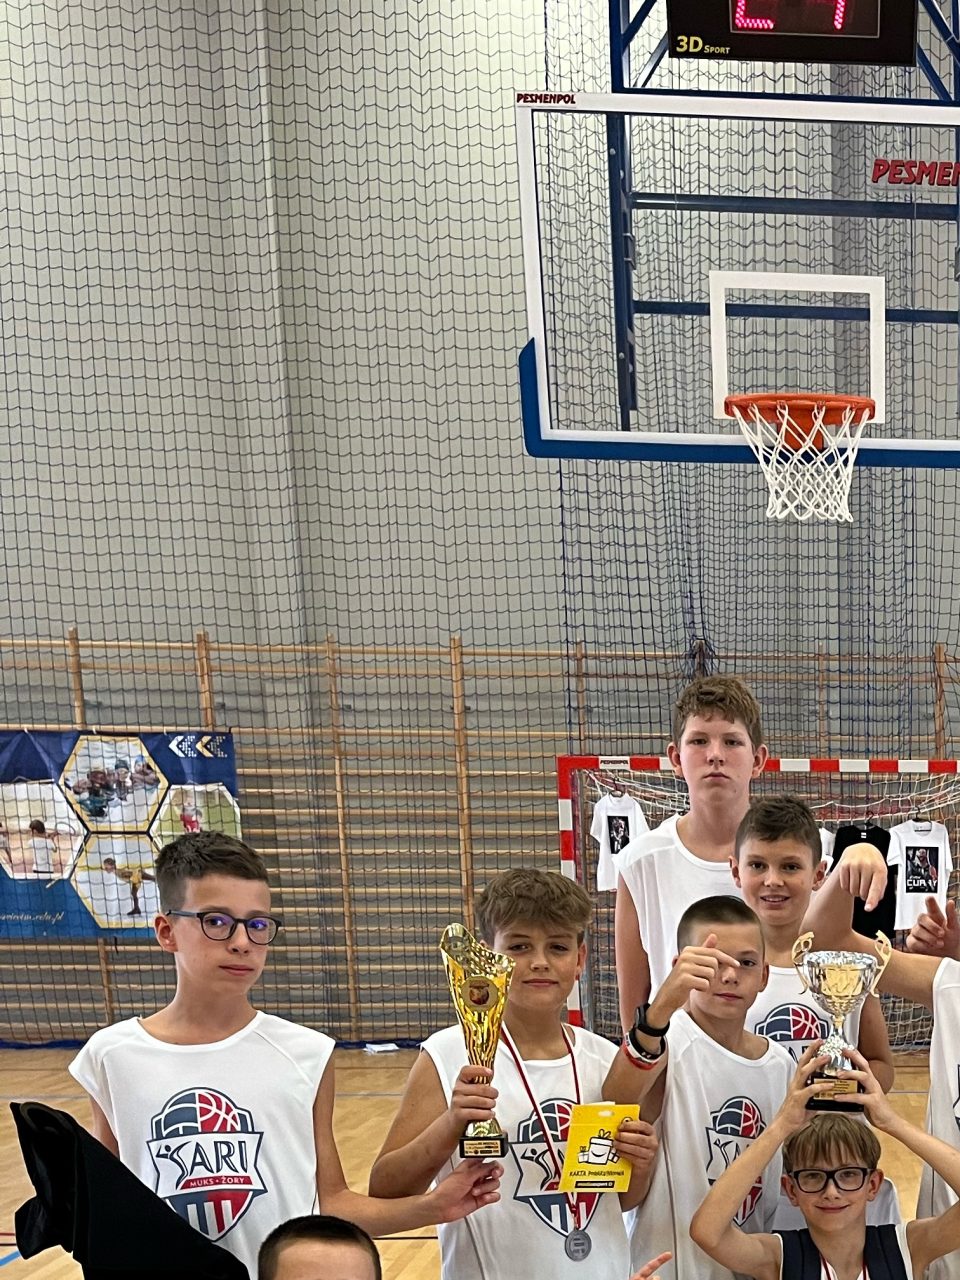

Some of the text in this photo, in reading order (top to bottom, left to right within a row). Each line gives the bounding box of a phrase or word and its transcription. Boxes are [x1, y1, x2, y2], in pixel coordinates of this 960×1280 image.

[676, 35, 704, 53] 3D
[516, 93, 576, 104] PESMENPOL
[156, 1140, 248, 1191] SARI
[189, 1175, 246, 1187] MUKS ŻORY
